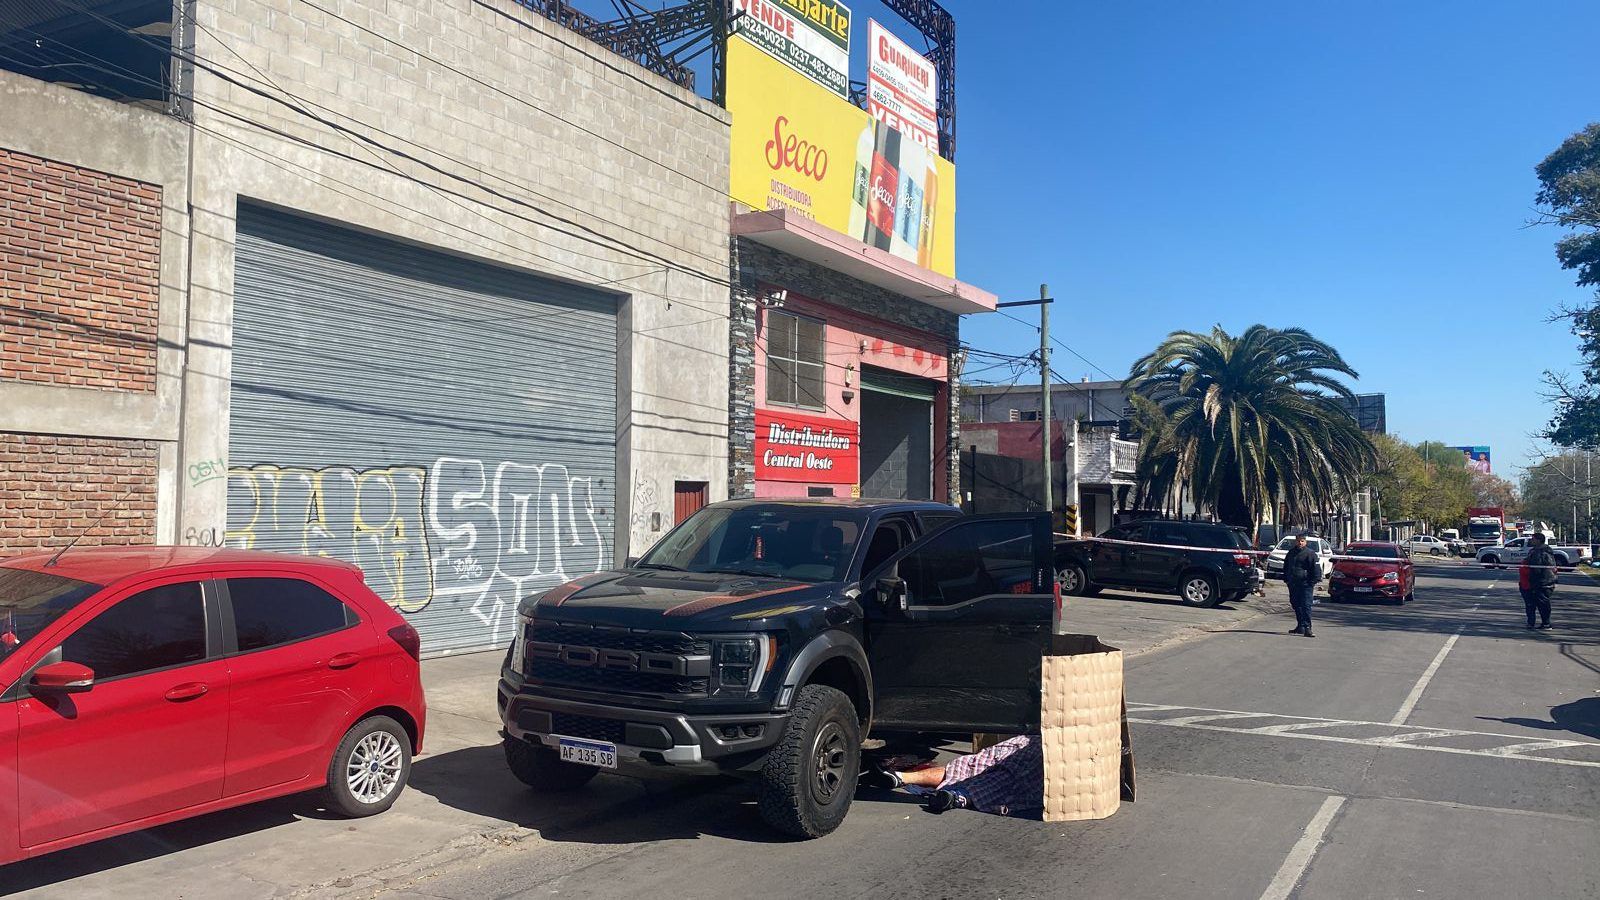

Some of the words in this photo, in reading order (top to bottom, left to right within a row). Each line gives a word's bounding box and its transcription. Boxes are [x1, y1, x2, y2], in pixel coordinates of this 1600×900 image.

[871, 102, 939, 152] VENDE
[765, 115, 828, 182] Secco
[770, 178, 813, 207] DISTRIBUIDORA
[871, 175, 894, 207] Secco
[768, 422, 850, 450] Distribuidora
[763, 449, 804, 468] Central
[806, 452, 833, 470] Oeste
[562, 746, 575, 759] AF
[577, 749, 597, 763] 135
[600, 752, 613, 766] SB
